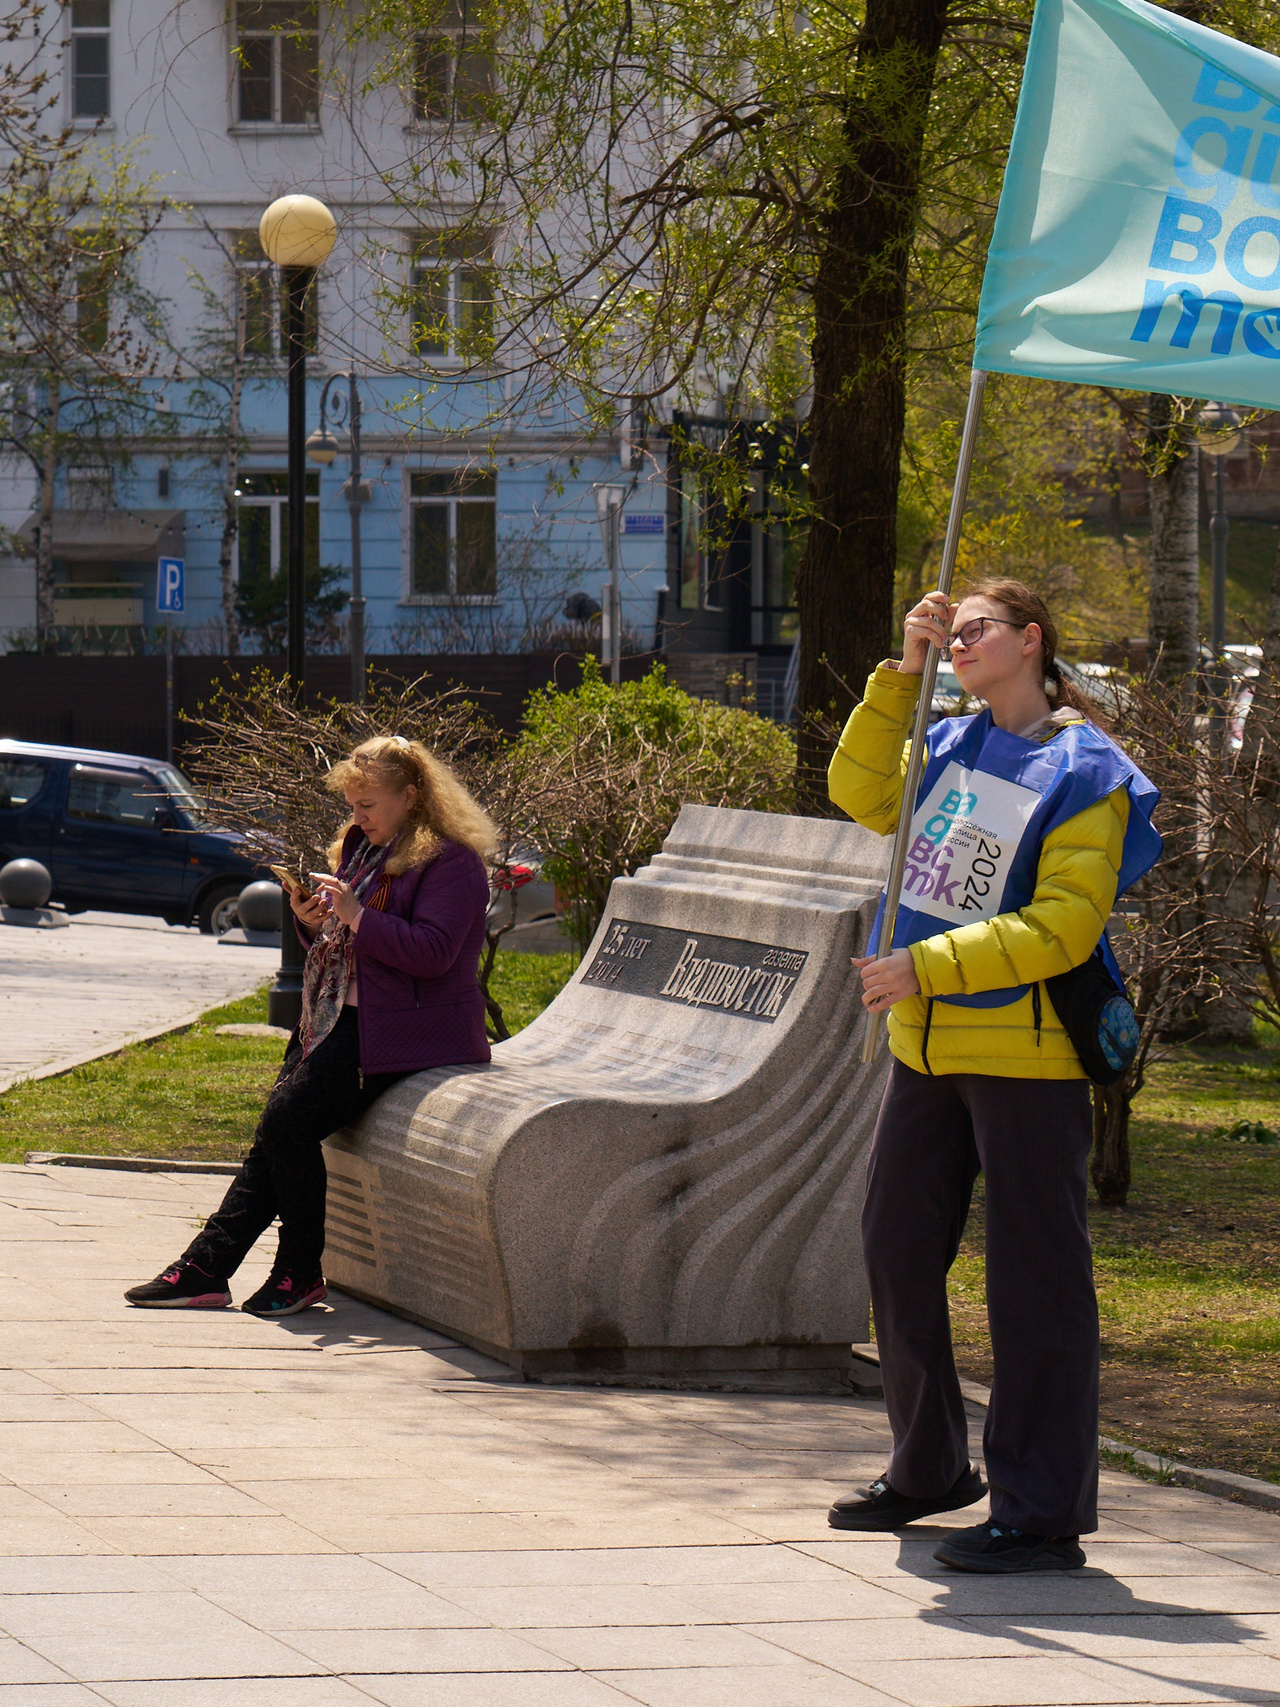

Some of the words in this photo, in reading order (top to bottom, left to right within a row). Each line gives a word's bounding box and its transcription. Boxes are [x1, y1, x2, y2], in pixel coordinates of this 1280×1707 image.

[166, 564, 180, 607] P
[953, 818, 998, 839] олодёжная
[958, 838, 1002, 911] 2024
[602, 925, 629, 955] 25
[620, 936, 651, 959] лет
[588, 960, 624, 983] 2014
[762, 949, 806, 970] газета
[660, 938, 796, 1018] Владивосток
